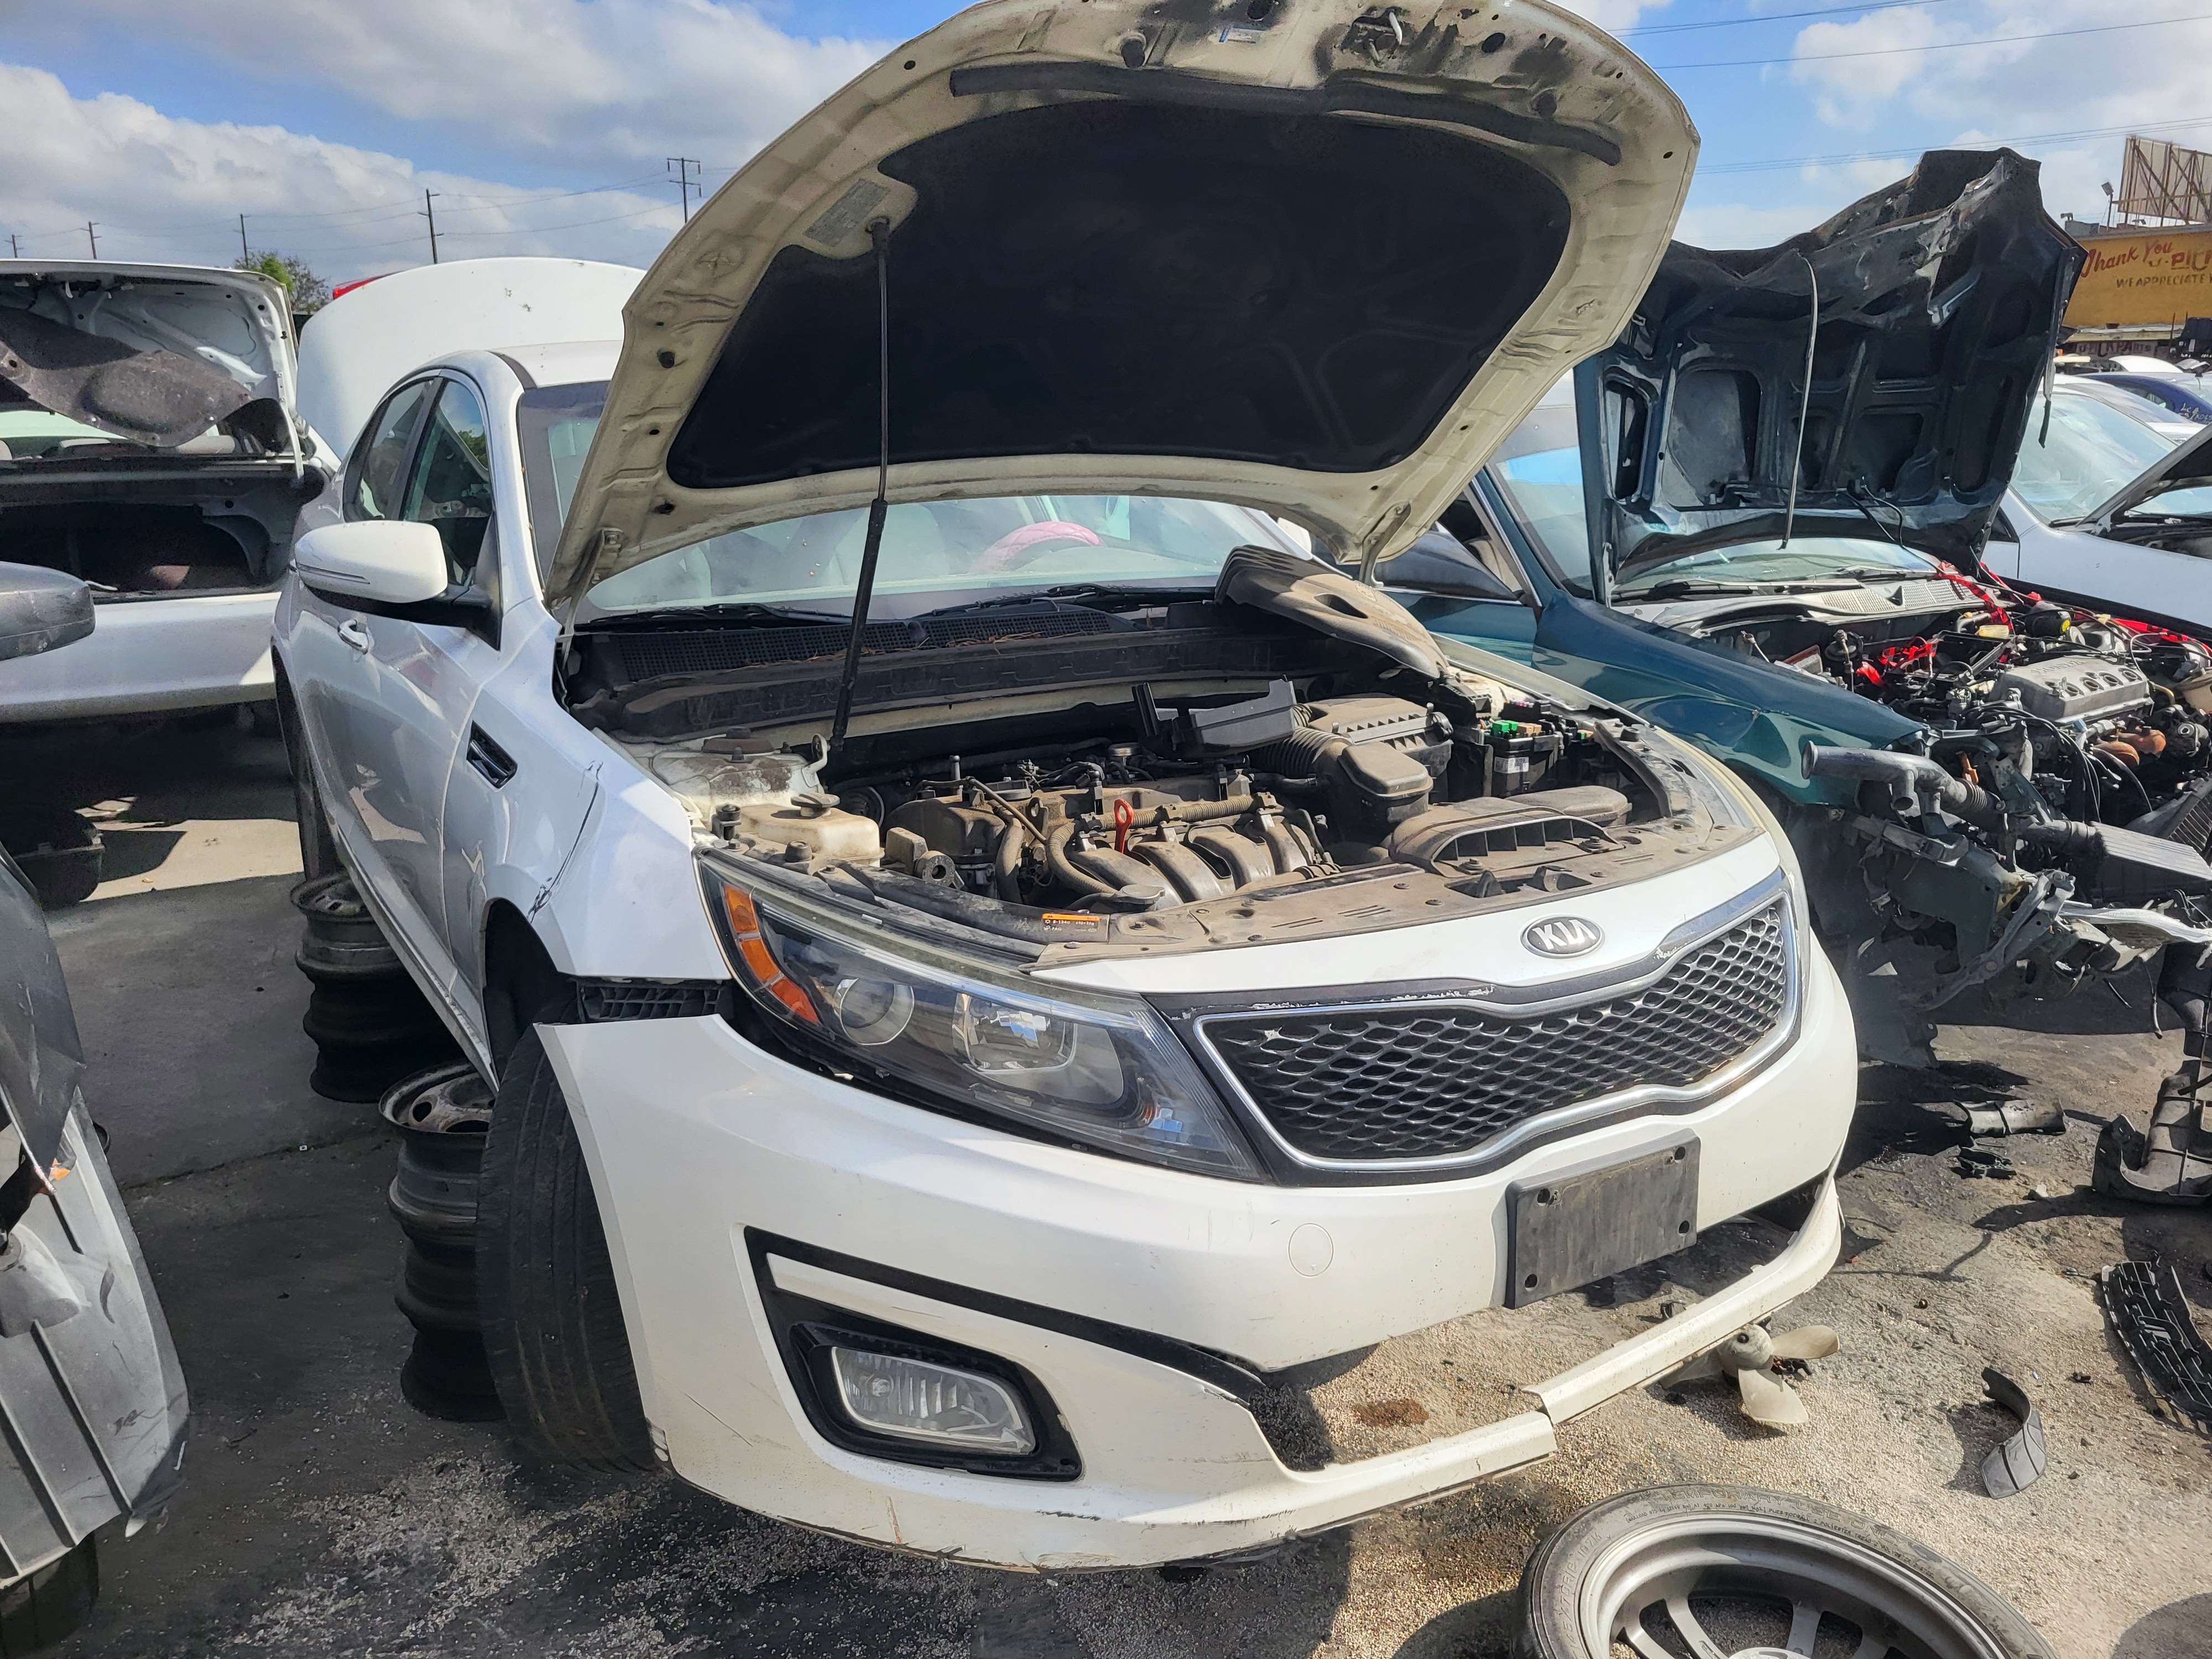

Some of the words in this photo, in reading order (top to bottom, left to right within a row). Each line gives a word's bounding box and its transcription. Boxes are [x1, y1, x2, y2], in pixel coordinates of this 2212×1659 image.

[2080, 247, 2139, 278] Thank
[2142, 239, 2172, 263] You
[2117, 278, 2133, 288] WE
[2136, 274, 2204, 287] APPRECIATE
[1531, 919, 1597, 950] KIA
[1657, 1486, 1785, 1505] TEMPORARY
[1796, 1499, 1841, 1522] USE
[1850, 1517, 1907, 1546] ONLY
